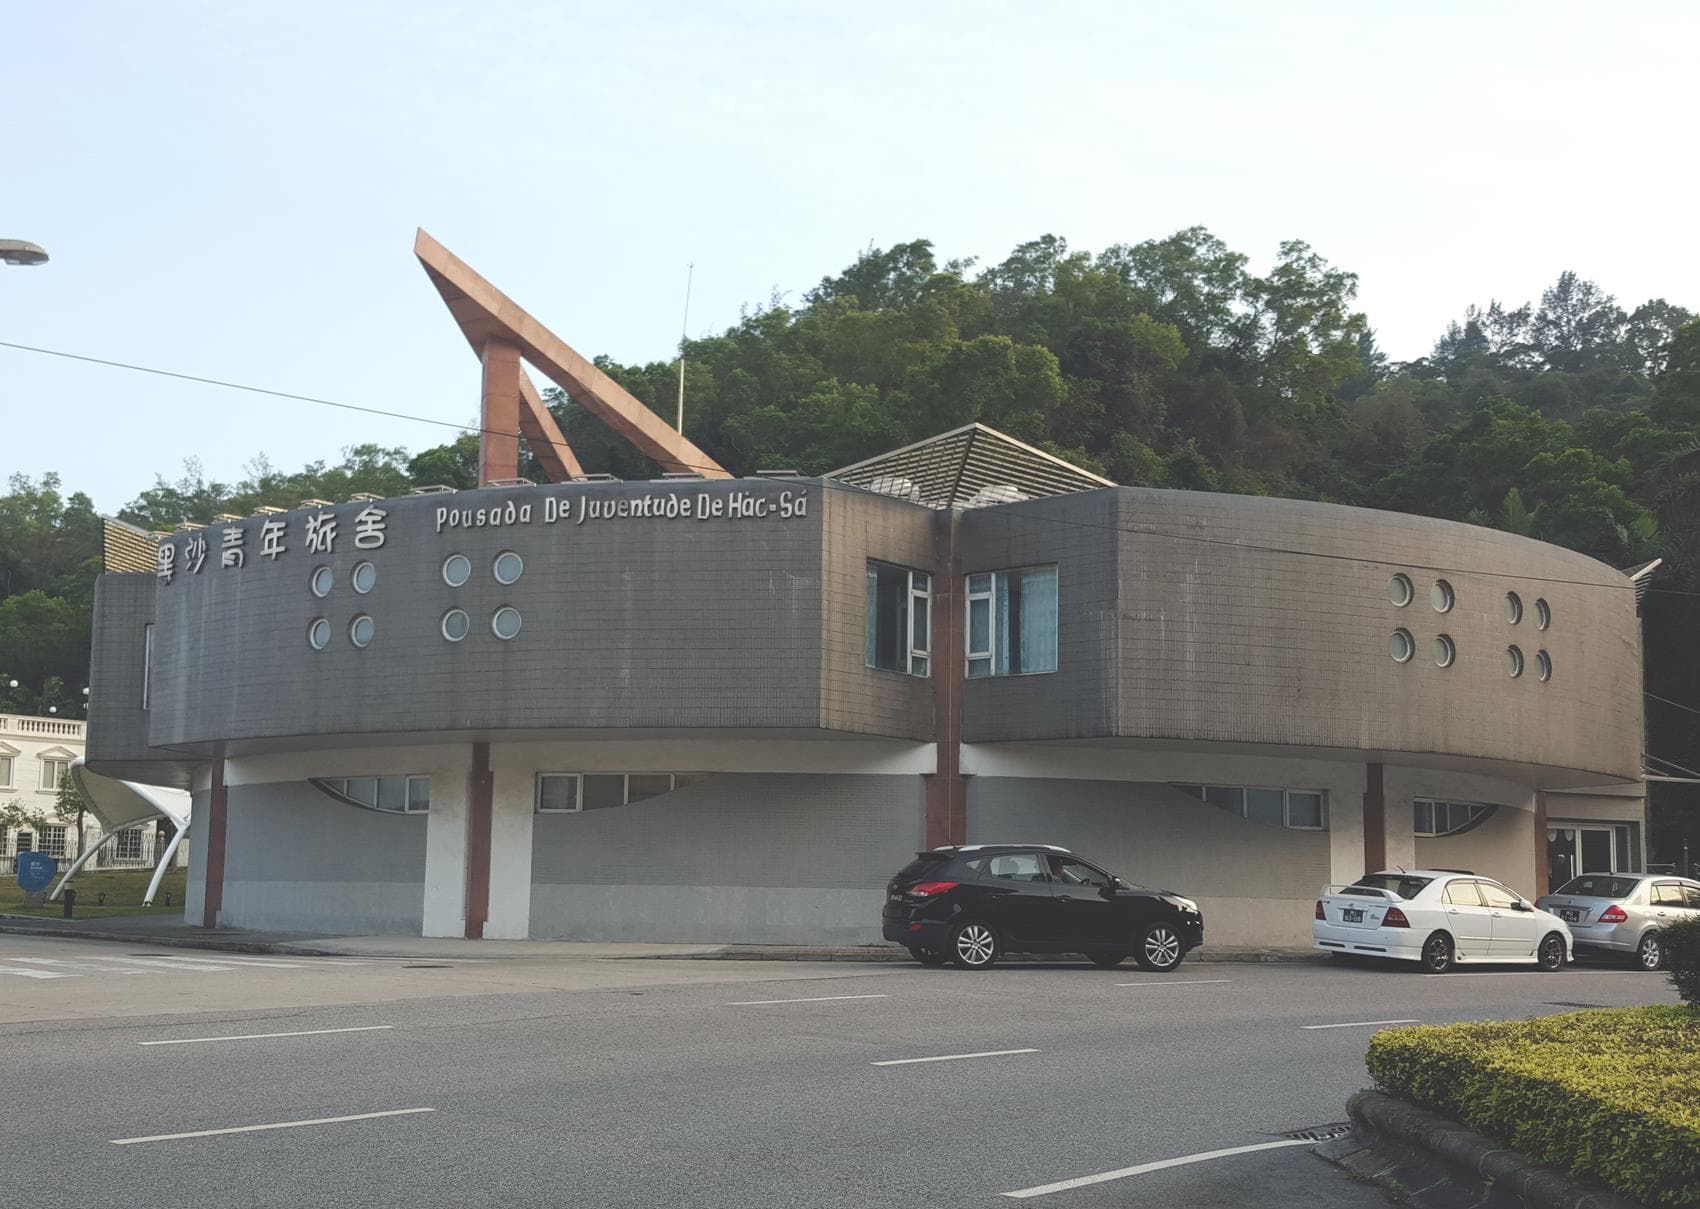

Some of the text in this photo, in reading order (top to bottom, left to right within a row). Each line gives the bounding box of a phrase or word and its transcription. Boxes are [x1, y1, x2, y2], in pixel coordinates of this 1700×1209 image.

[436, 500, 531, 532] Pousada
[544, 496, 569, 523] De
[577, 493, 690, 525] Juventude
[697, 493, 723, 519] De
